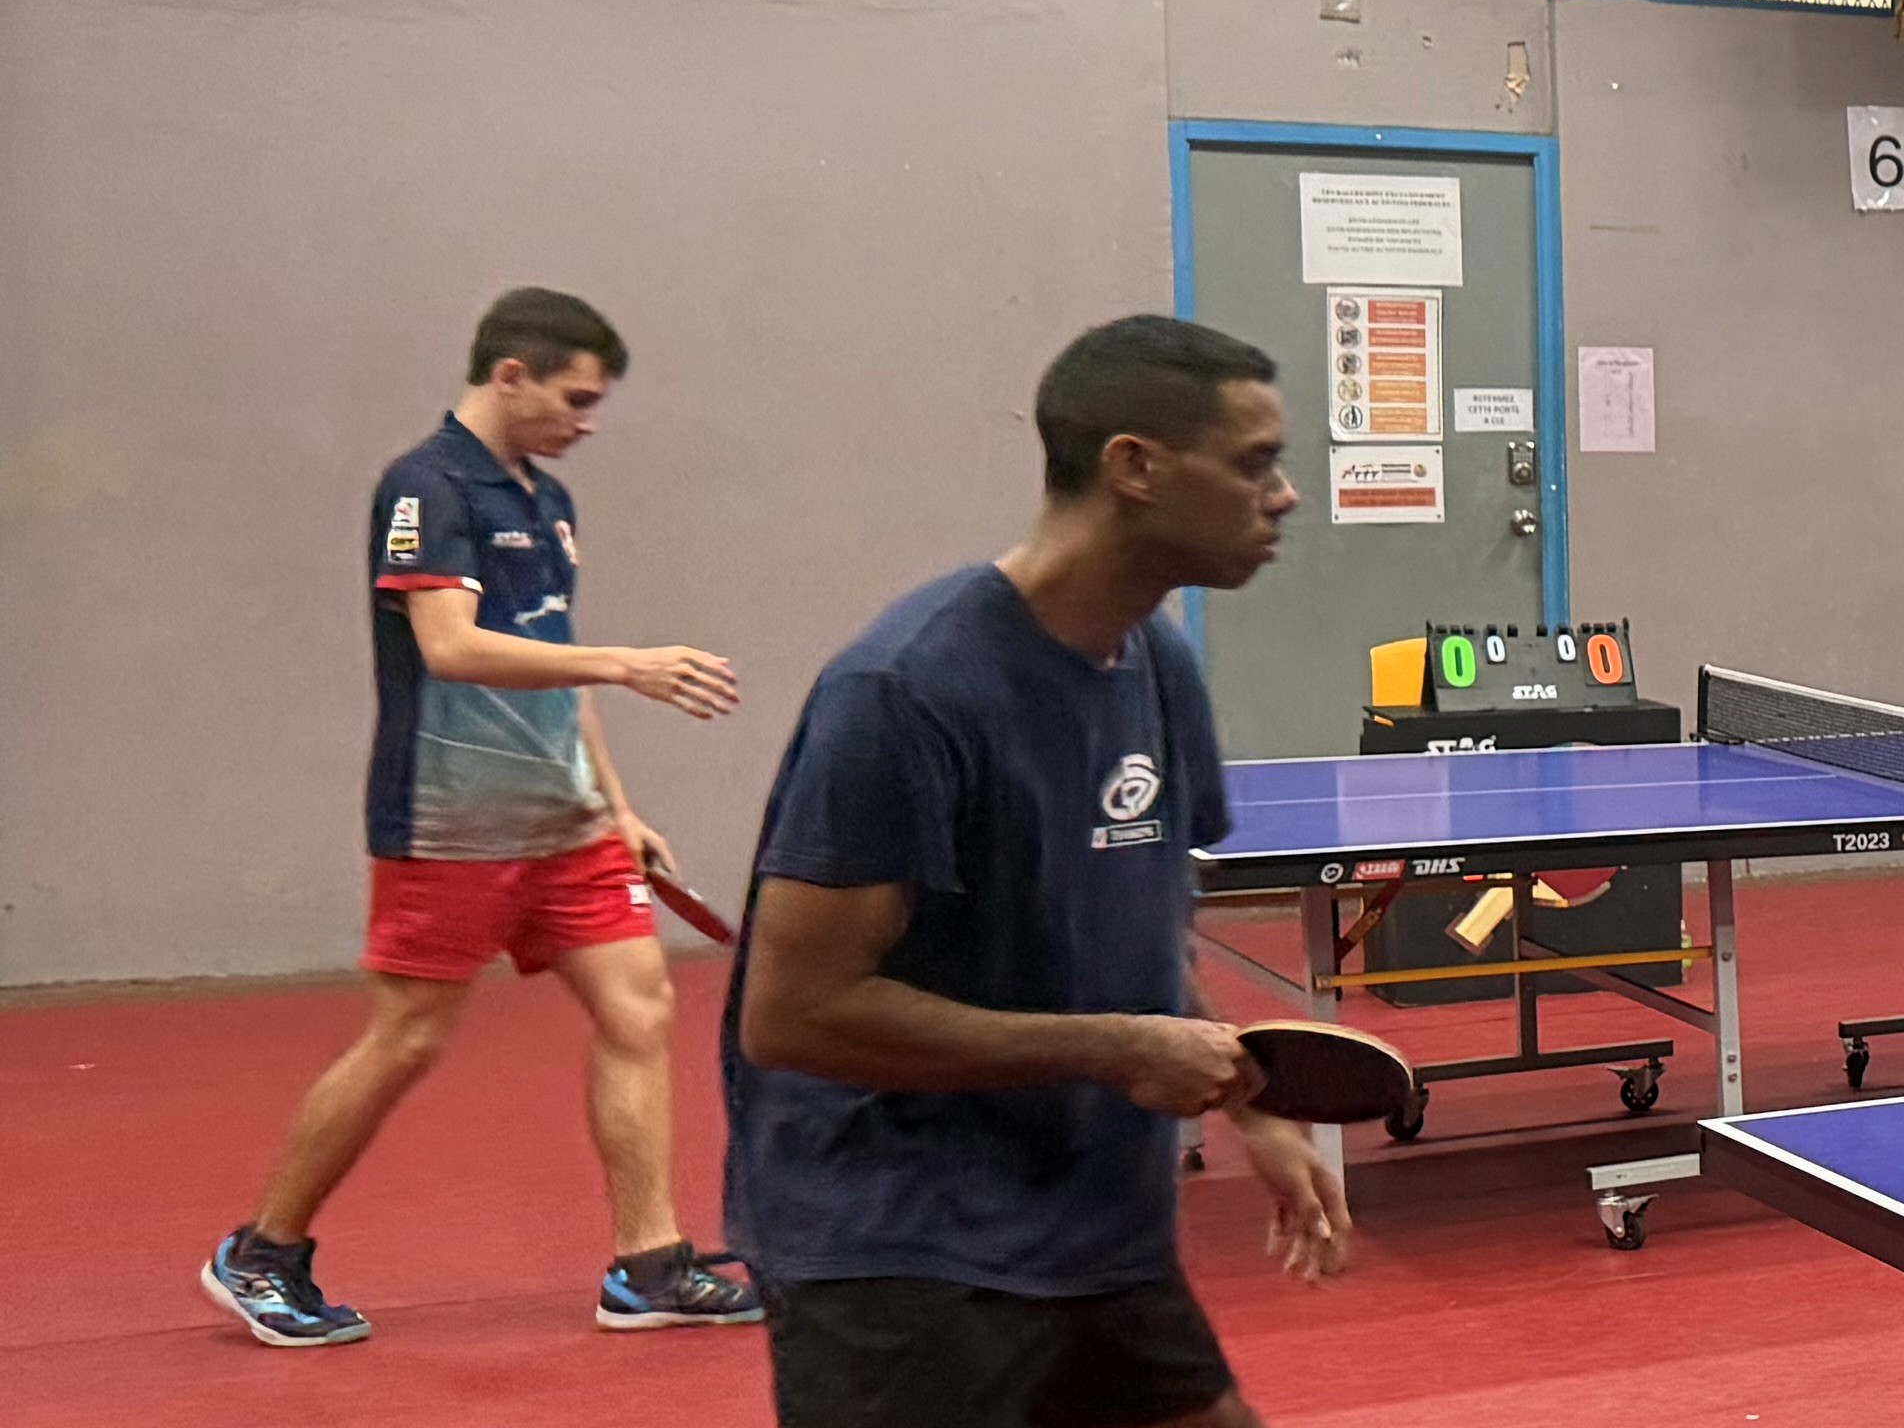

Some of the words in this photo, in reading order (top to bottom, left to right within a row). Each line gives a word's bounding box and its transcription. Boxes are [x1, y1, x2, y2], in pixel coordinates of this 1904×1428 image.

[1868, 135, 1904, 187] 6
[1442, 635, 1476, 687] 0
[1487, 635, 1505, 663] 0
[1558, 634, 1576, 661] 0
[1587, 634, 1623, 685] 0
[1512, 684, 1558, 700] STAG
[1833, 832, 1890, 852] T2023
[1412, 856, 1466, 876] DHS
